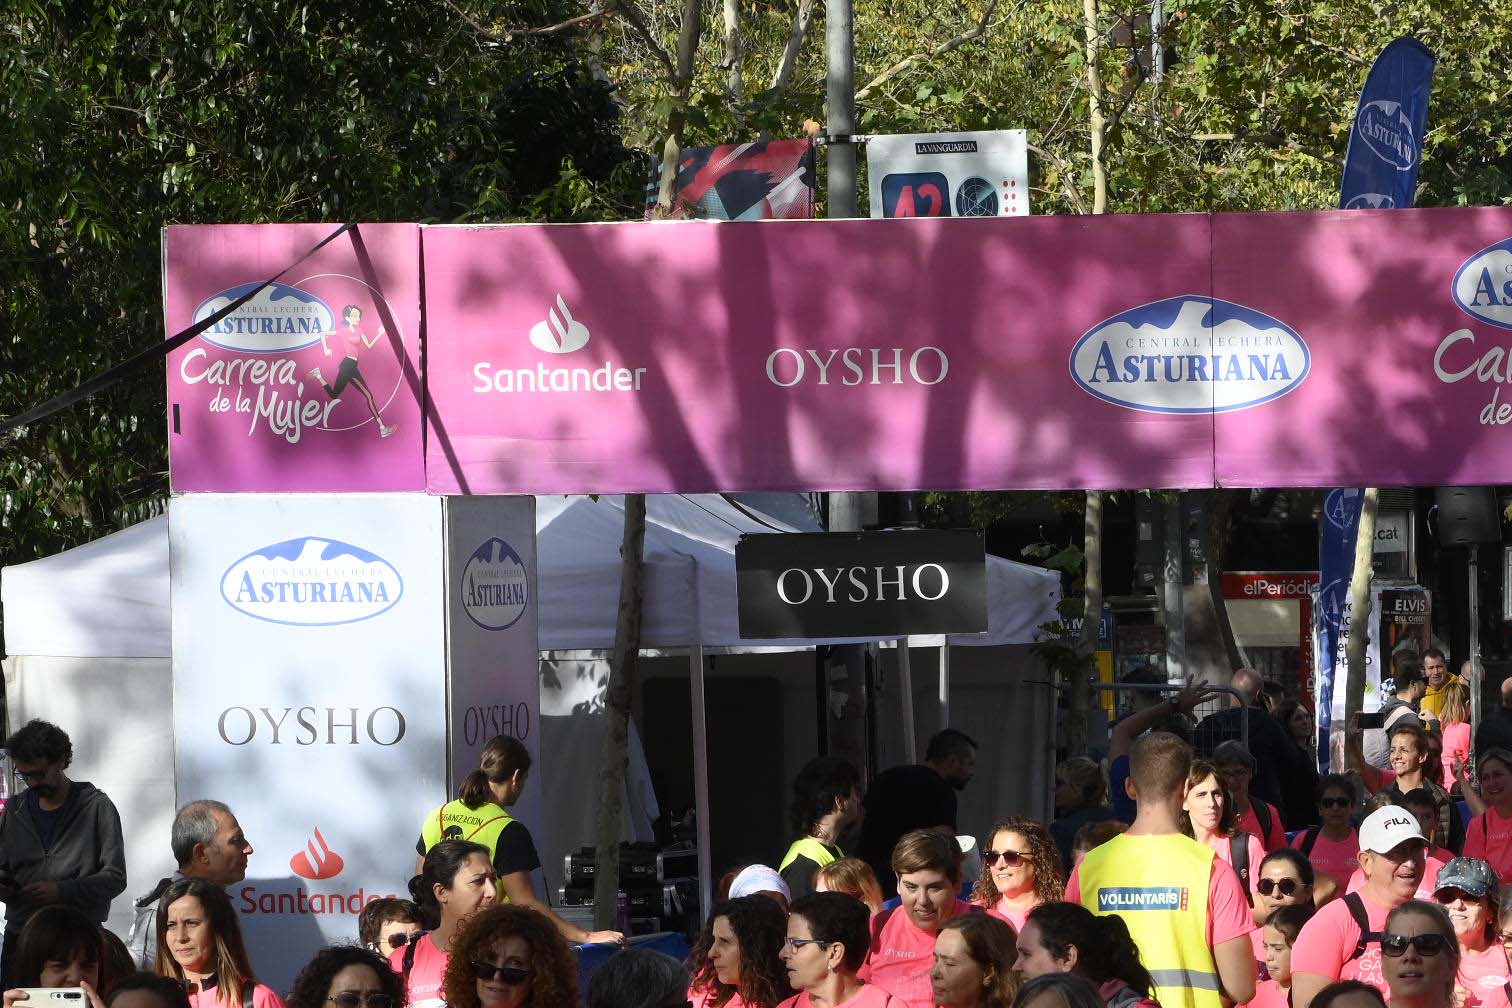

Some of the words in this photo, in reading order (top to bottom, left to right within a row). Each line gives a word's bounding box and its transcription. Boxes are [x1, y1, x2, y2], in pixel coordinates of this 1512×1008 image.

[203, 307, 323, 334] ASTURIANA
[1125, 336, 1201, 349] CENTRAL
[1208, 334, 1284, 347] LECHERA
[181, 347, 297, 386] Carrera
[472, 360, 647, 394] Santander
[765, 346, 949, 387] OYSHO
[1089, 340, 1292, 384] ASTURIANA
[209, 387, 231, 412] de
[235, 386, 252, 412] la
[248, 382, 342, 444] Mujer
[1374, 526, 1398, 540] .cat
[235, 569, 391, 603] ASTURIANA
[262, 567, 320, 577] CENTRAL
[324, 567, 384, 576] LECHERA
[776, 563, 950, 606] OYSHO
[467, 572, 525, 608] ASTURIANA
[1395, 599, 1425, 612] ELVIS
[218, 706, 406, 745] OYSHO
[464, 702, 530, 746] OYSHO
[1384, 818, 1411, 830] FILA
[1100, 889, 1179, 908] VOLUNTARIS
